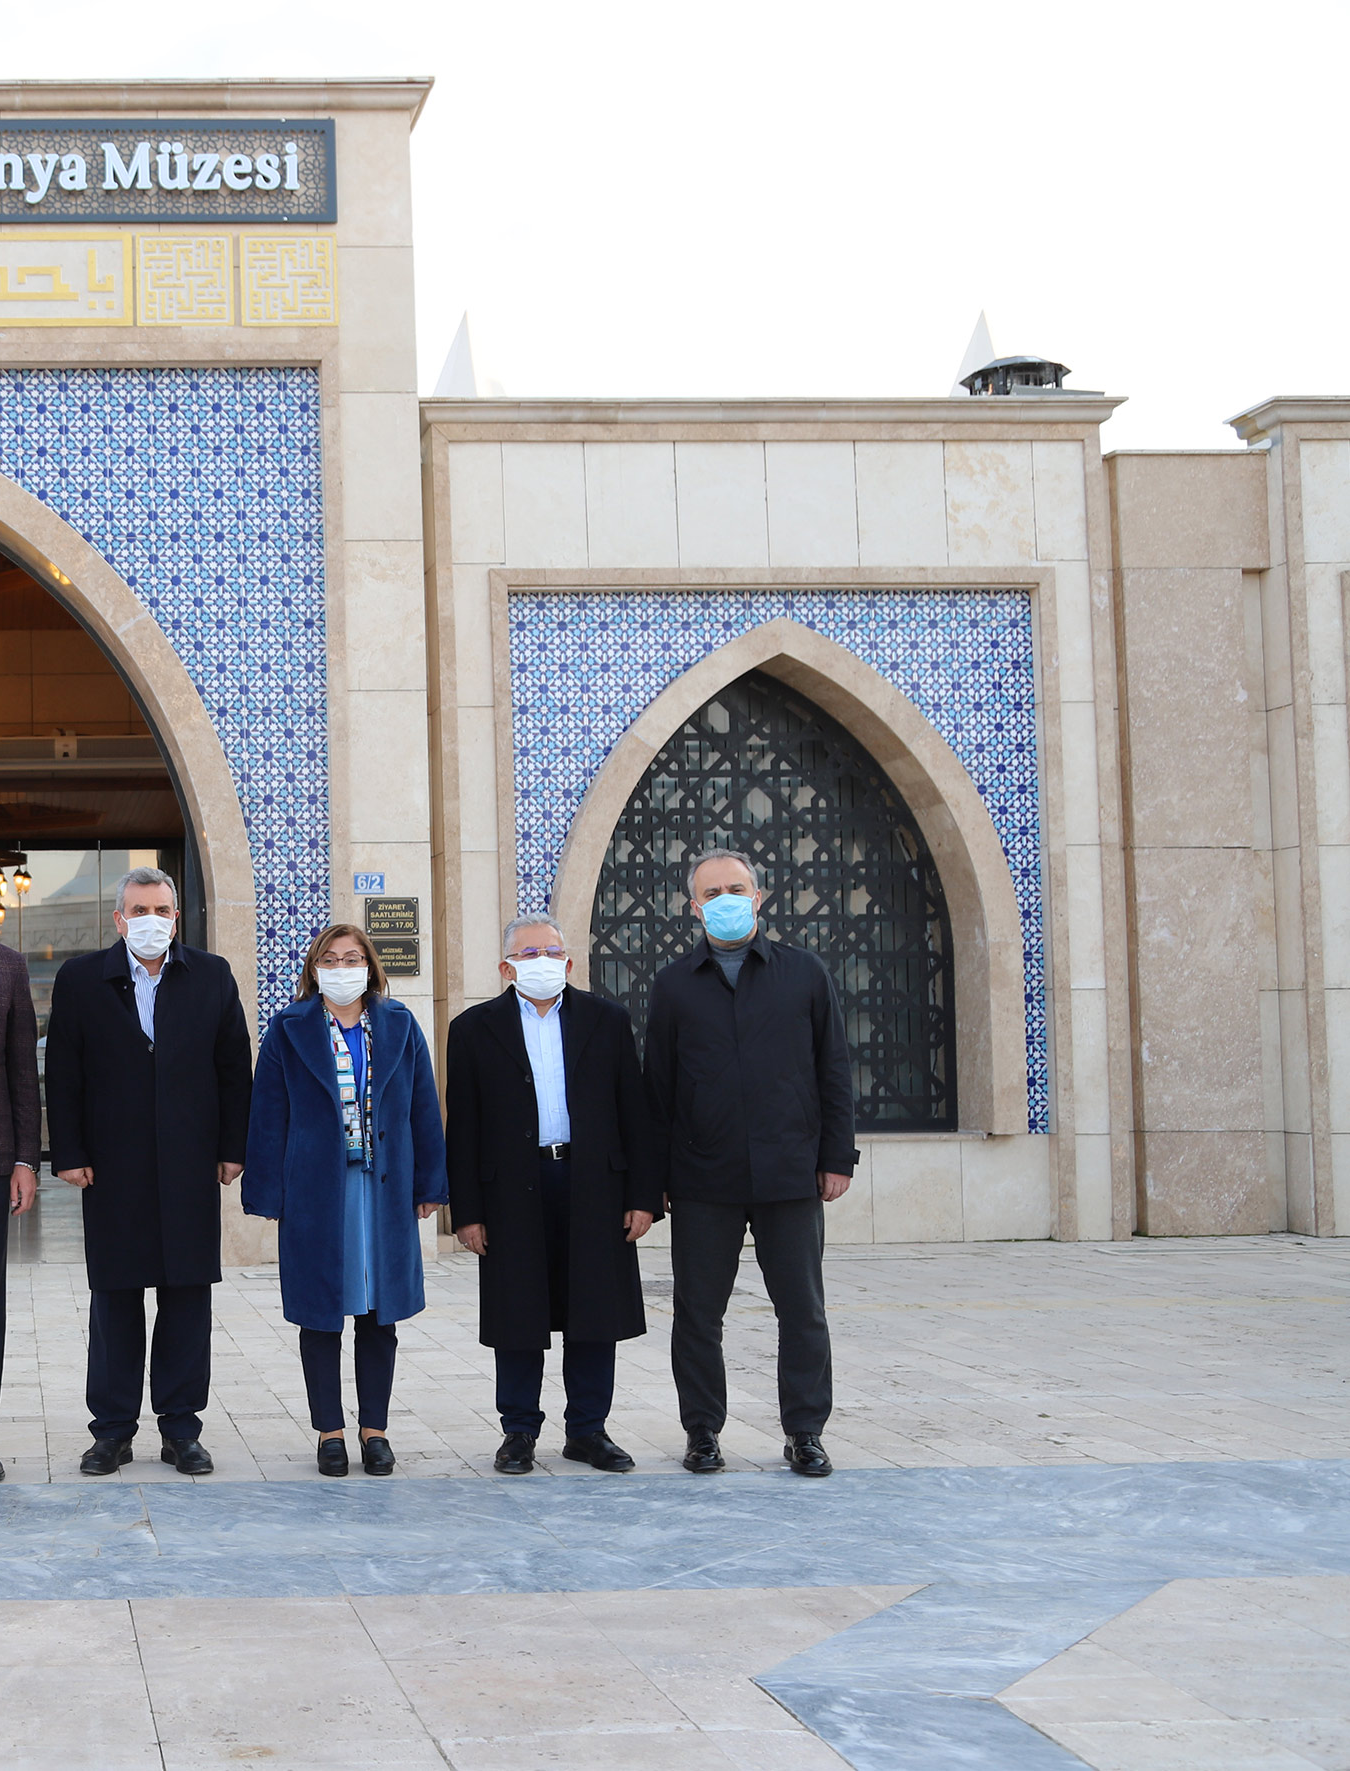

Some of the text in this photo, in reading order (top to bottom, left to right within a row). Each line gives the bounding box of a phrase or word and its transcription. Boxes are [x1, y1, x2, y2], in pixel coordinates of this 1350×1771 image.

[101, 141, 300, 191] Müzesi
[357, 875, 381, 890] 6/2
[378, 903, 406, 911] ZİYARET
[371, 921, 390, 929] 09.00
[396, 921, 414, 929] 17.00
